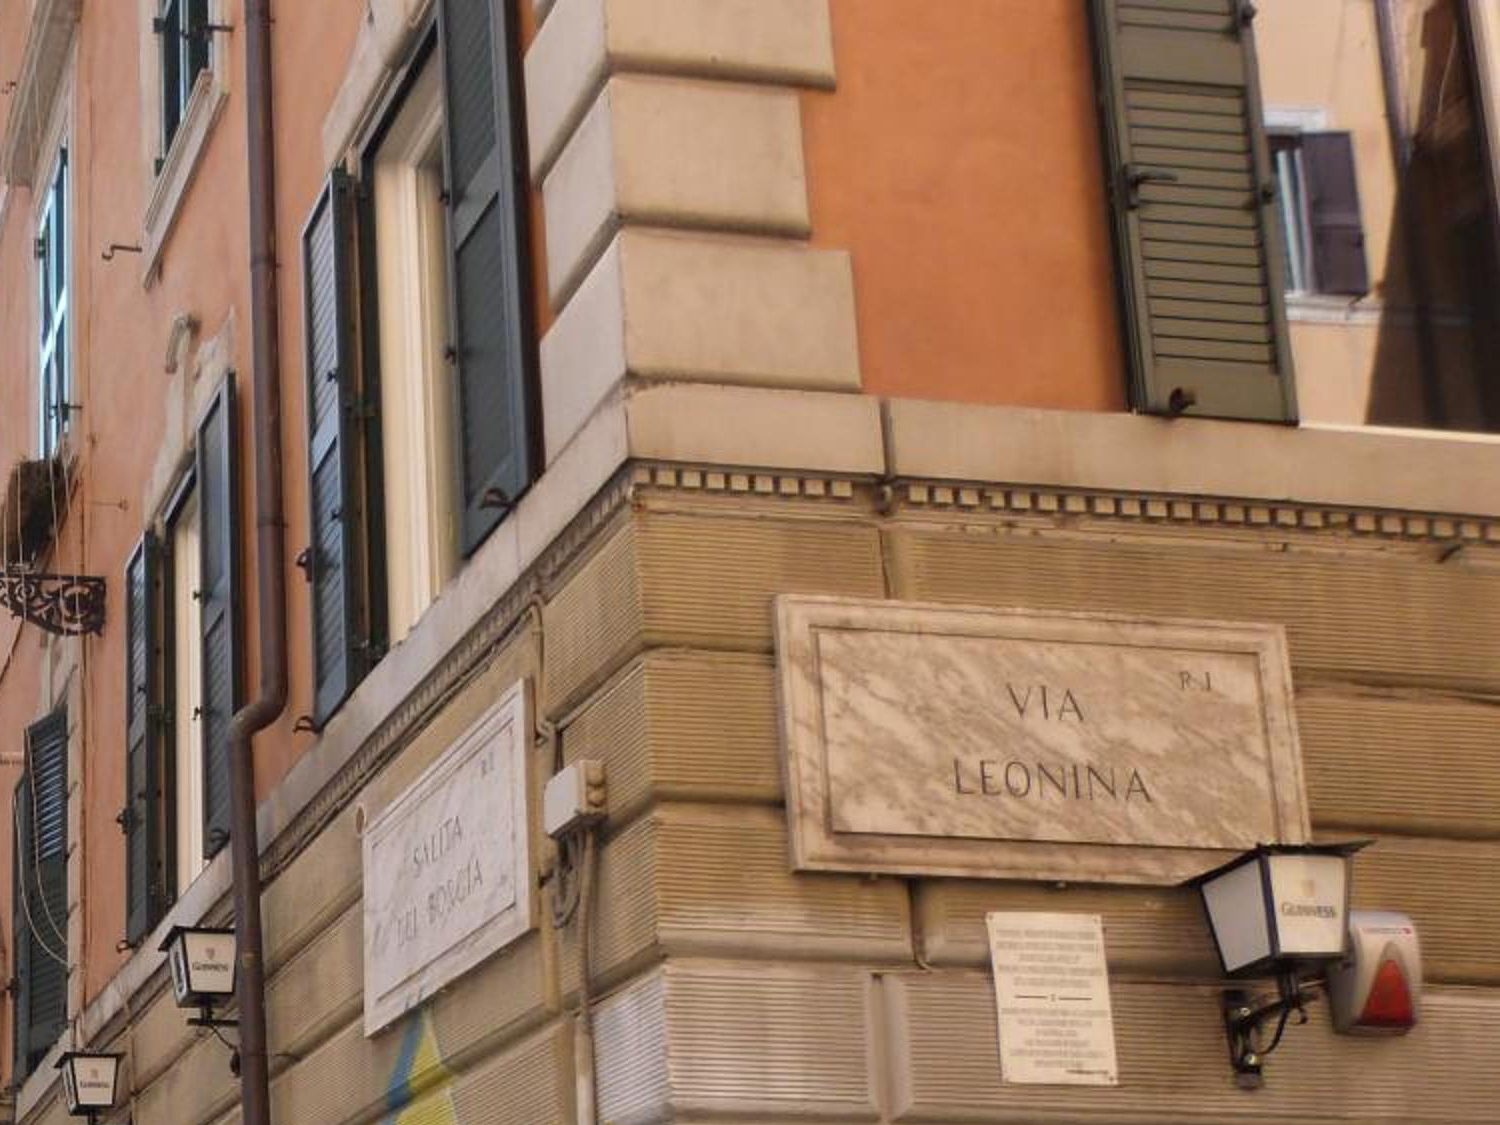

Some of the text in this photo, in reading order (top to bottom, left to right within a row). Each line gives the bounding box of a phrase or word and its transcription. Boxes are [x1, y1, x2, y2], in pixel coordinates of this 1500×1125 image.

[1005, 682, 1084, 721] VIA
[953, 758, 1153, 803] LEONINA
[412, 815, 463, 877] SALITA
